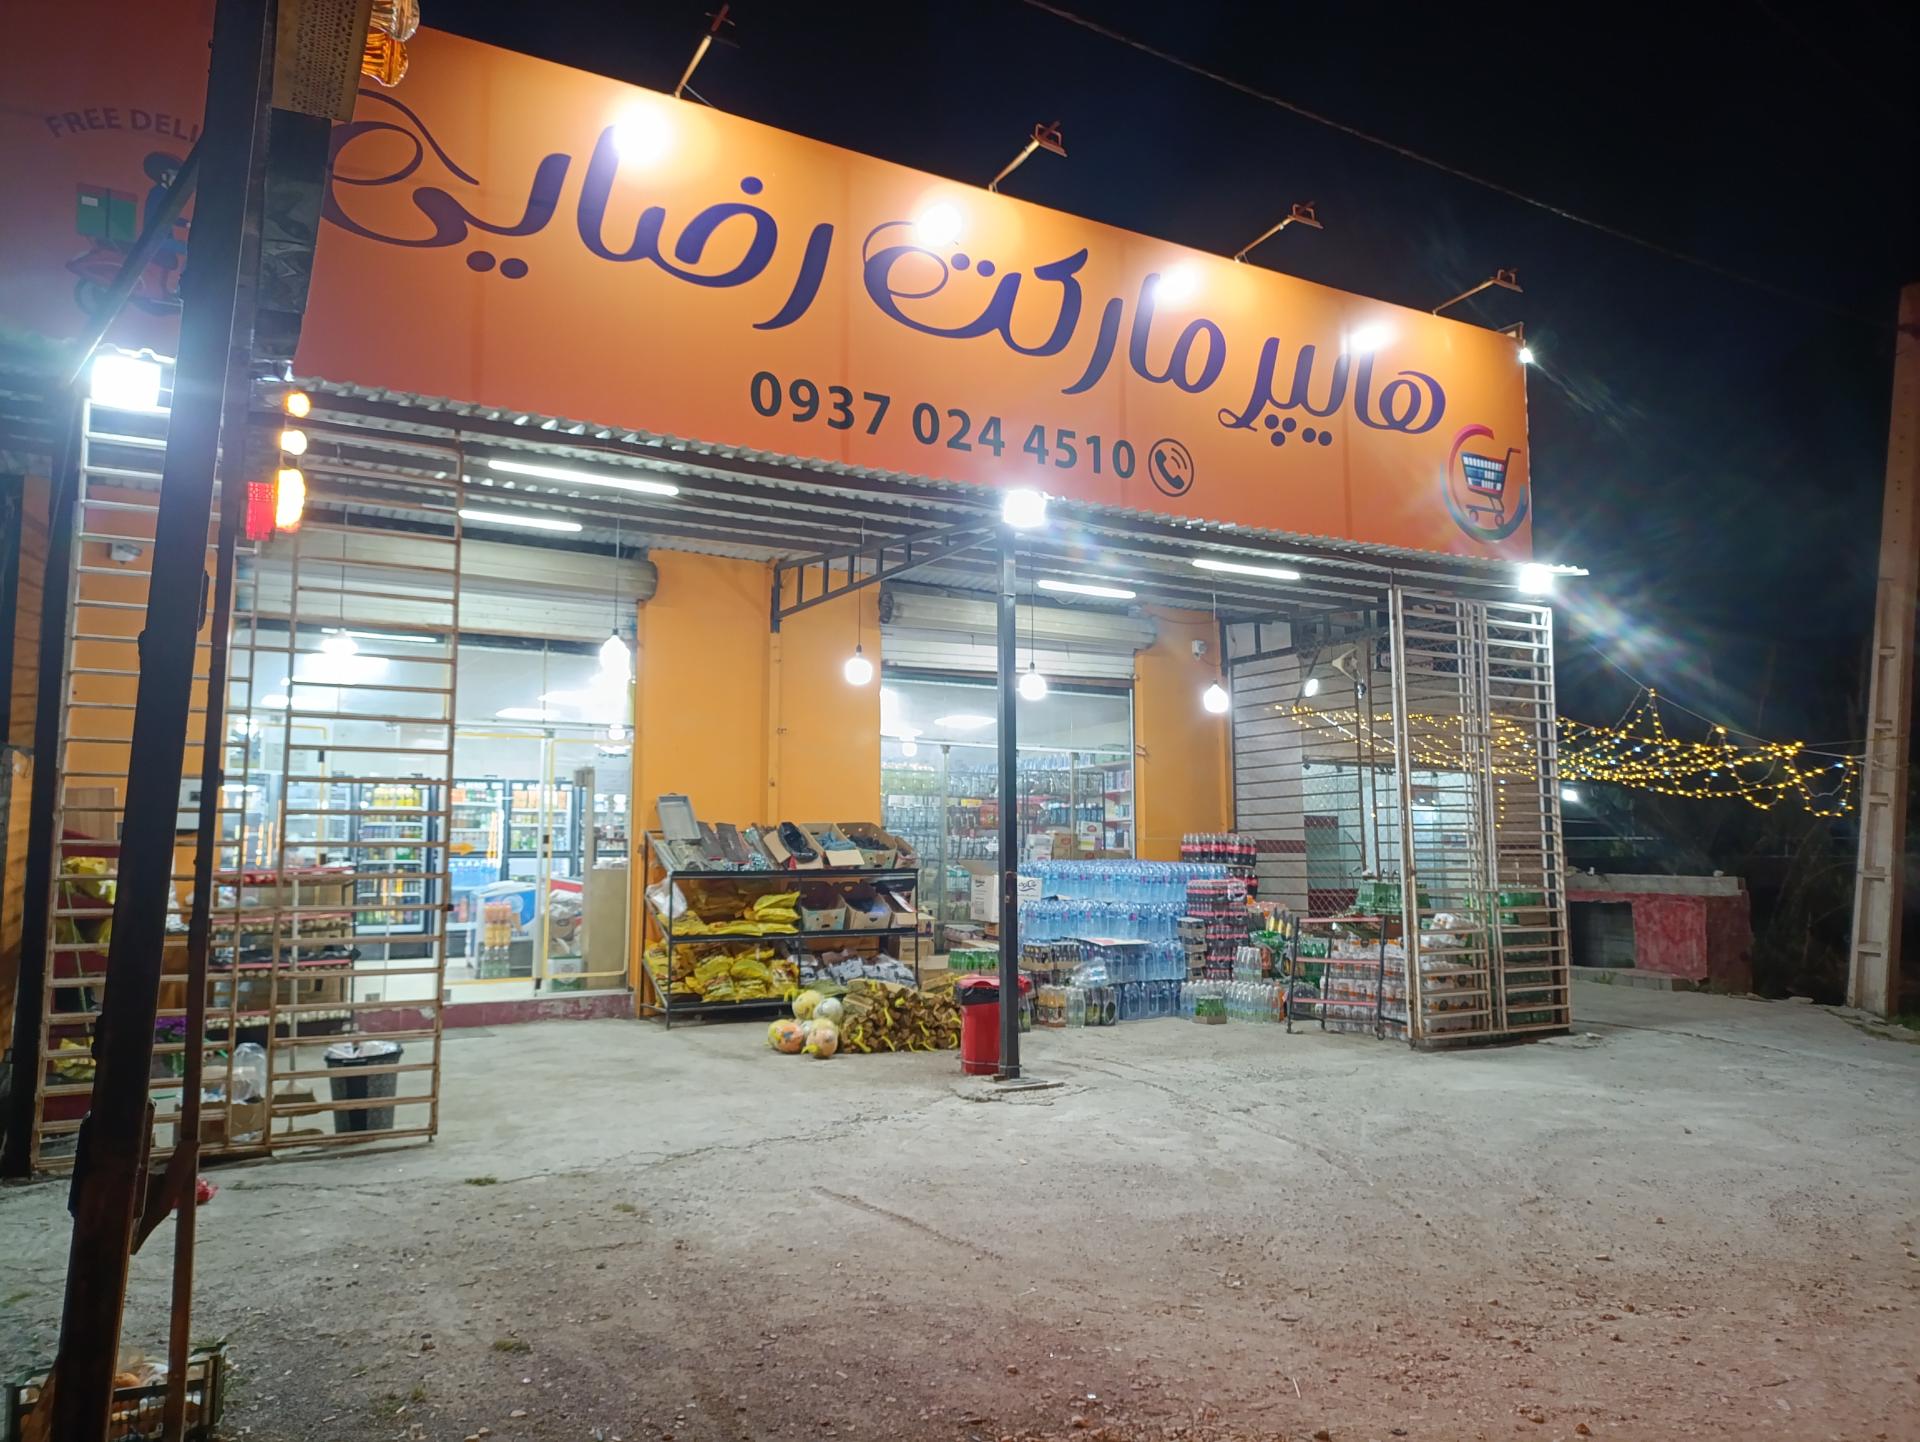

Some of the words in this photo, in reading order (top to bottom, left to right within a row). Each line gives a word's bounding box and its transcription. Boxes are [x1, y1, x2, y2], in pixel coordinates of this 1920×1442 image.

[45, 108, 121, 138] FREE
[130, 108, 199, 143] DELI
[863, 221, 1227, 395] مارکت
[750, 371, 891, 436] 0937
[912, 402, 1006, 458] 024
[1023, 424, 1136, 480] 4510
[1218, 336, 1446, 447] هایپر
